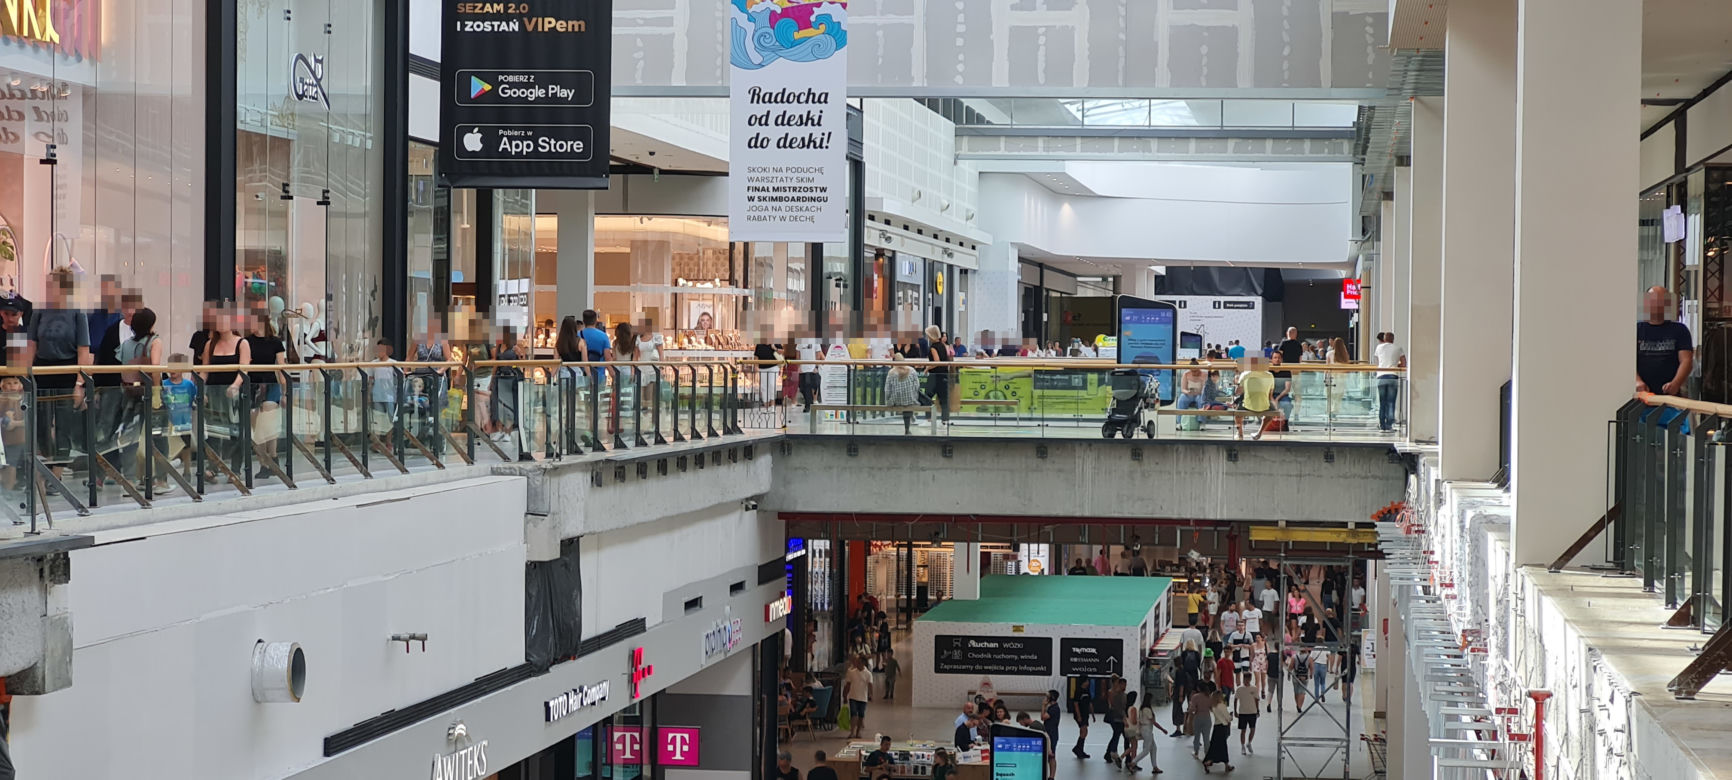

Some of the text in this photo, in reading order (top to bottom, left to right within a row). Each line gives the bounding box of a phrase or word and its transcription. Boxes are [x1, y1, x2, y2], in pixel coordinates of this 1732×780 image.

[457, 3, 529, 14] SEZAM 2.0
[456, 17, 586, 32] I ZOSTAŃ VIPem
[498, 75, 535, 83] POBIERZ Z
[498, 84, 575, 101] Google Play
[748, 86, 829, 104] Radocha
[747, 110, 823, 127] od deski
[498, 137, 584, 155] App Store
[747, 131, 832, 149] do deski!
[747, 166, 824, 175] SKOKI NA PODUCHĘ
[746, 205, 769, 213] JOGA
[789, 215, 815, 224] DECHĘ
[968, 640, 999, 648] Auchan
[940, 663, 974, 672] Zapraszamy
[549, 680, 610, 722] TOTO Hair Company
[613, 731, 641, 759] T
[667, 732, 690, 760] T
[435, 740, 488, 780] AWITEKS
